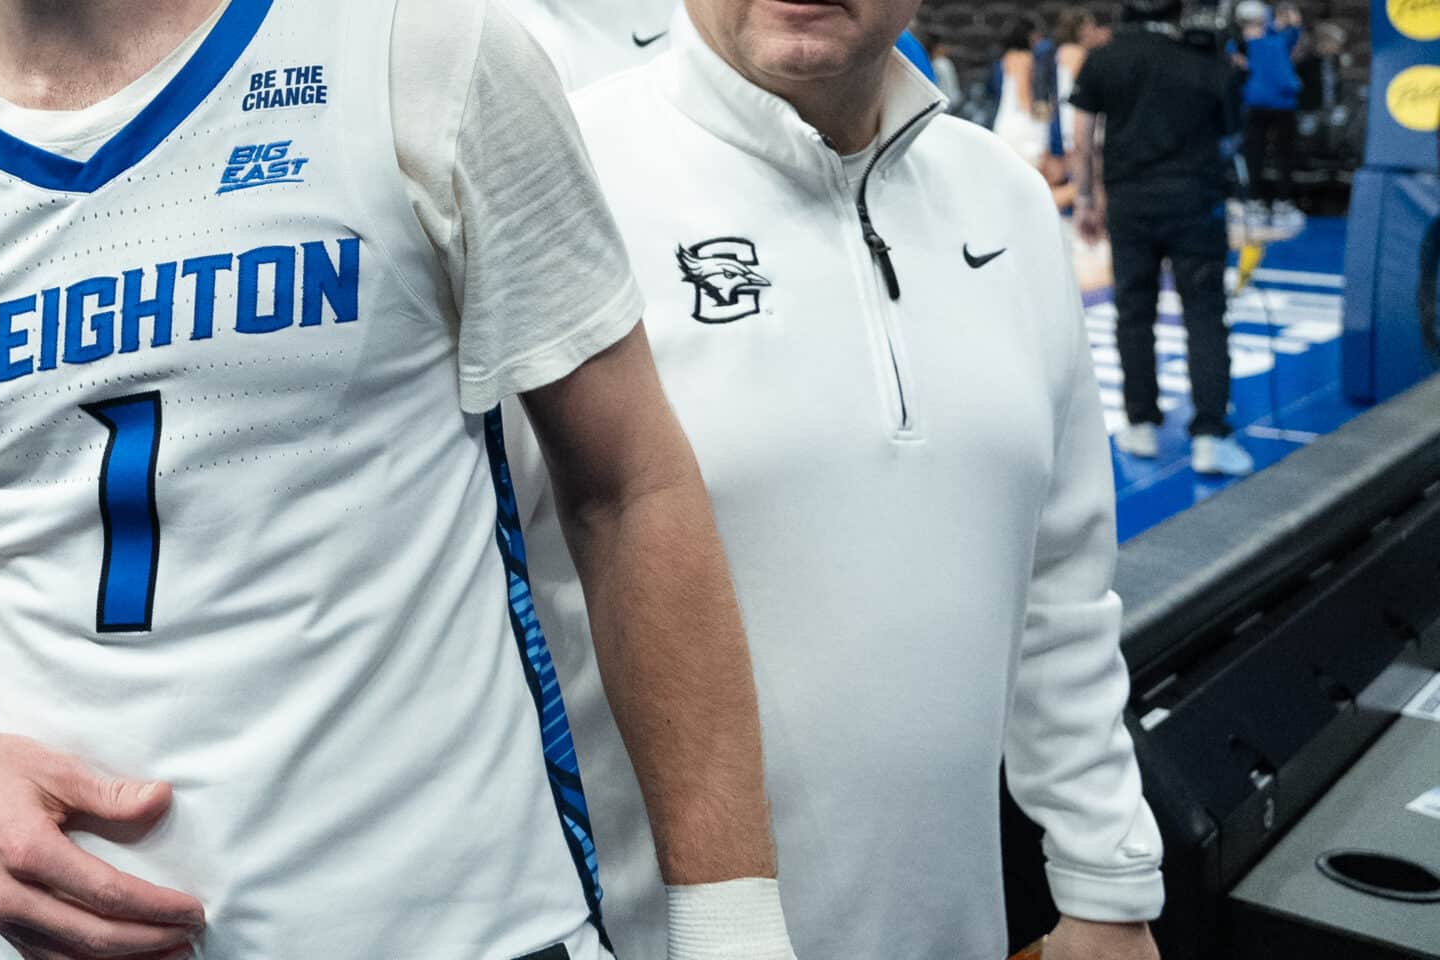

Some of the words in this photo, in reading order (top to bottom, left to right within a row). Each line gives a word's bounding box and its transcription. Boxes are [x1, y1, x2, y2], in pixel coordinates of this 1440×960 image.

[249, 69, 277, 92] BE
[283, 65, 324, 87] THE
[241, 85, 328, 112] CHANGE
[228, 139, 293, 166] BIG
[219, 157, 309, 185] EAST
[78, 390, 162, 633] 1
